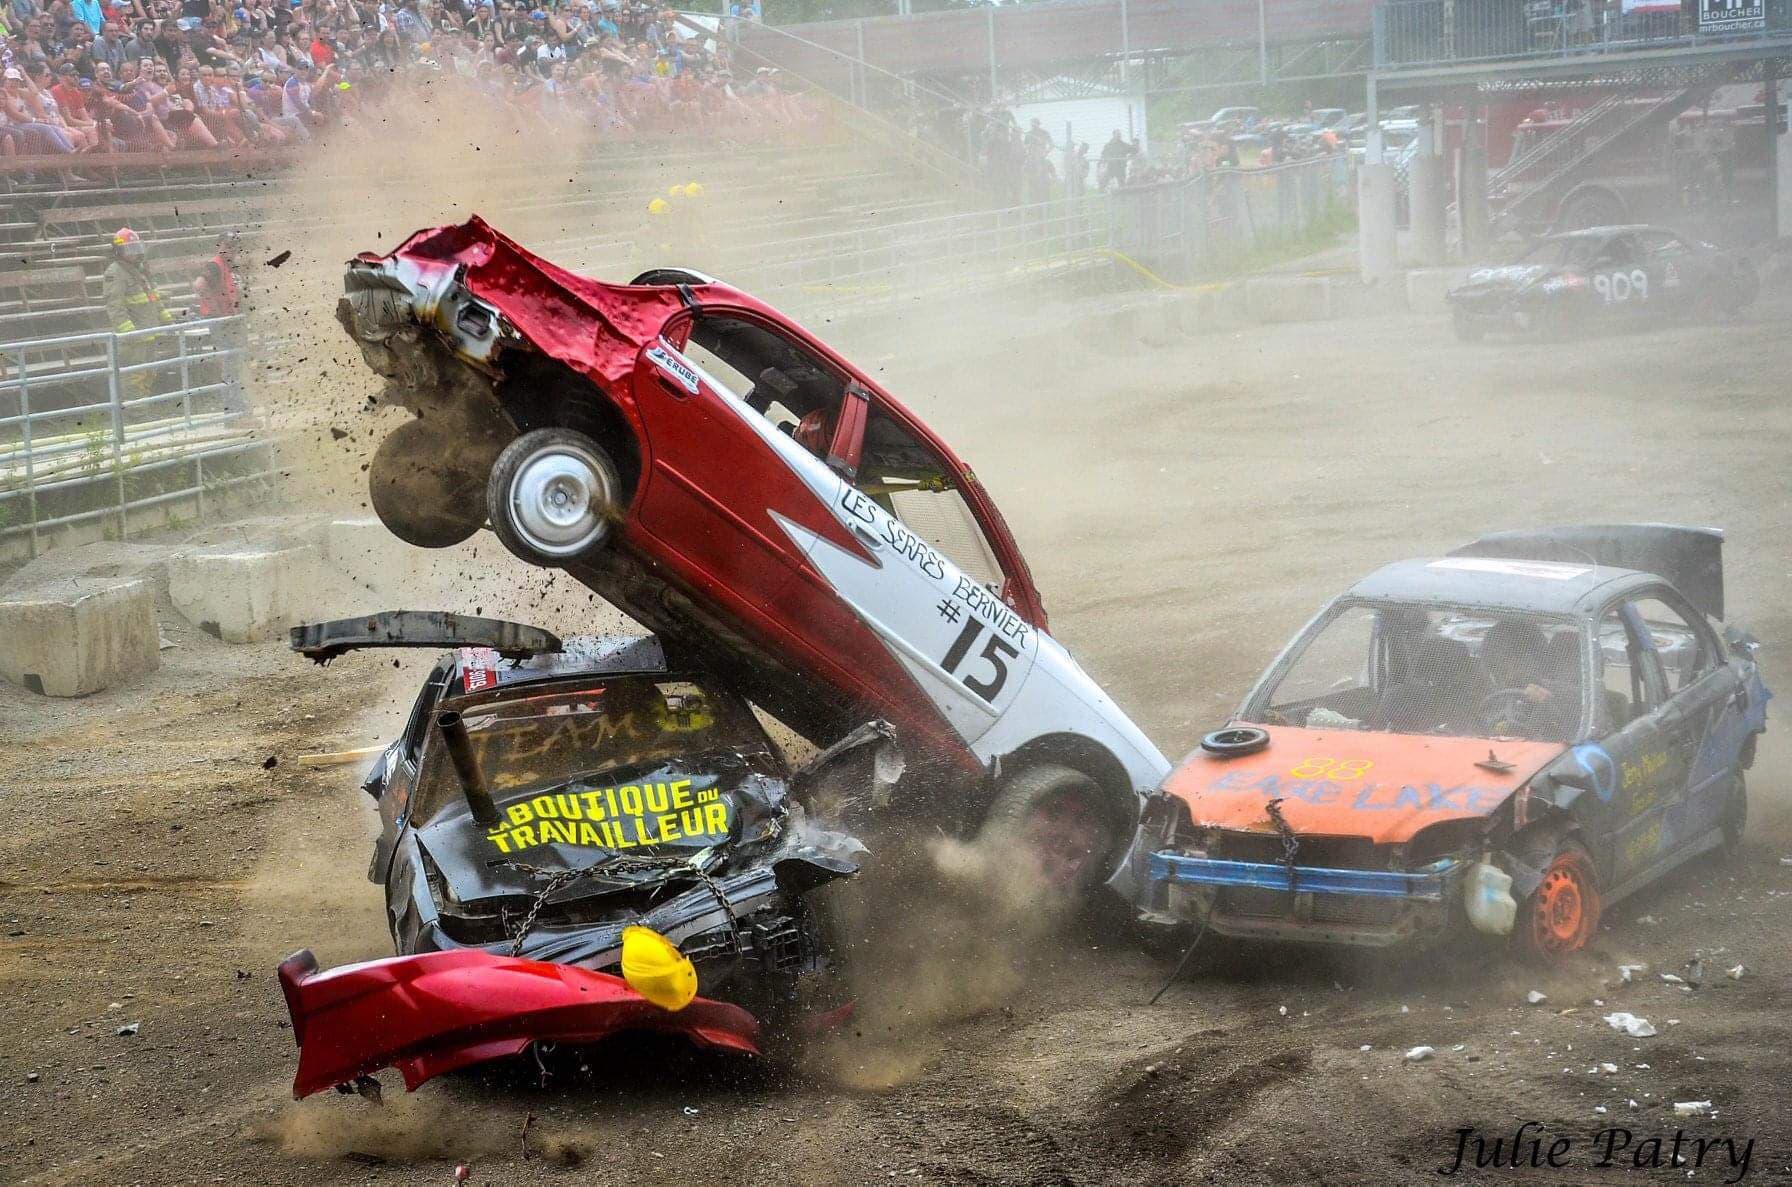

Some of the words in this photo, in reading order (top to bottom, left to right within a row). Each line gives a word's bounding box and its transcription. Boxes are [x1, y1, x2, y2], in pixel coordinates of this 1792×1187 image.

[1703, 7, 1761, 20] BOUCHER
[1593, 269, 1649, 303] 909
[841, 489, 876, 524] LES
[880, 519, 945, 580] SERRES
[952, 576, 1031, 649] BERNIER
[1291, 758, 1374, 781] 88
[487, 820, 512, 834] LA
[506, 779, 694, 826] BOUTIQUE
[1352, 782, 1508, 814] LAKE
[487, 803, 729, 853] TRAVAILLEUR
